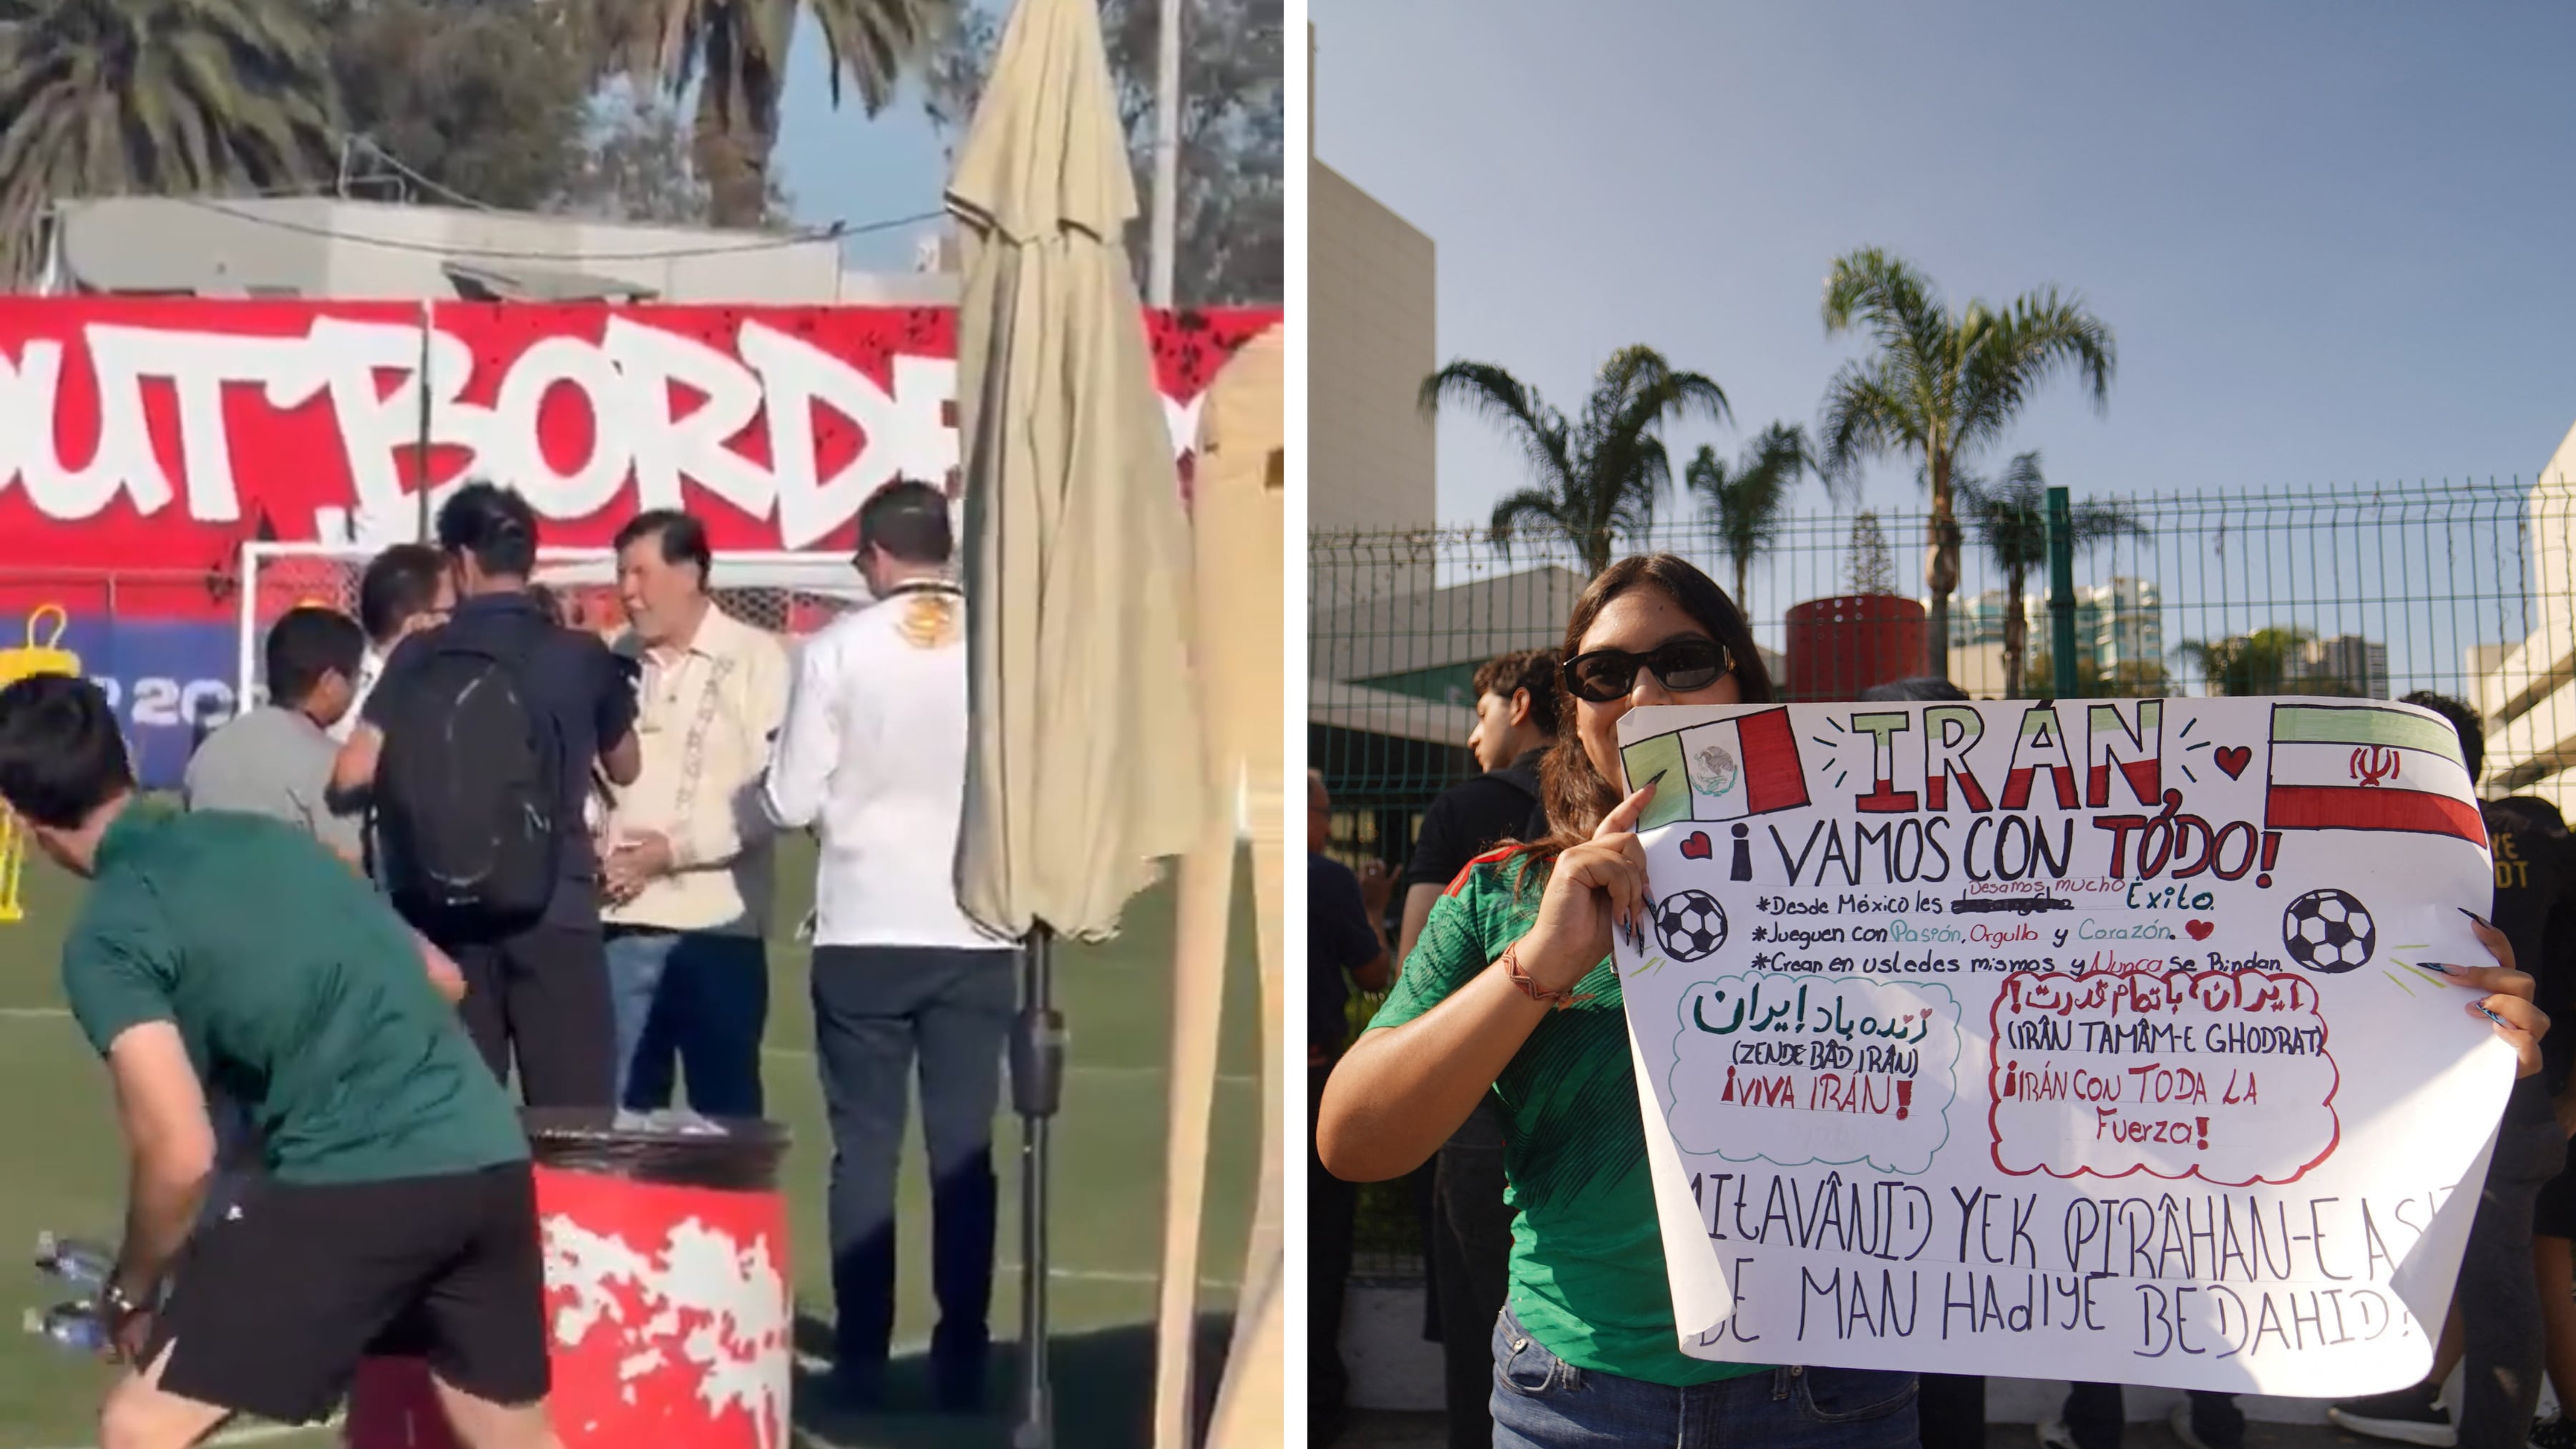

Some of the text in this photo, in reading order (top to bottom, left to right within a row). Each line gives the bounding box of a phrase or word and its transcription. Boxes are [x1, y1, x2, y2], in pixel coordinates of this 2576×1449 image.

[1851, 698, 2182, 821] IRÁN,
[1730, 818, 1951, 887] ¡VAMOS
[1963, 814, 2073, 882] CON
[1915, 889, 1943, 914] les
[2055, 876, 2126, 893] mucho
[1852, 926, 1888, 943] con
[1970, 923, 2039, 949] Orgullo
[2052, 928, 2069, 948] y
[2078, 918, 2177, 940] Corazón.
[1828, 957, 1855, 972] en
[1971, 957, 2056, 972] mismos
[2069, 959, 2086, 977] y
[2089, 949, 2164, 973] Nunca
[2169, 955, 2197, 972] se
[1732, 1040, 1807, 1066] (ZENDE
[2205, 1022, 2326, 1057] GHODRAT)
[1720, 1065, 1913, 1121] ¡VIVA IRÁN!
[2128, 1063, 2207, 1106] TODA
[2222, 1068, 2258, 1106] LA
[2096, 1106, 2210, 1151] Fuerza!
[1951, 1185, 2038, 1269] YEK
[1797, 1266, 1918, 1342] MAN
